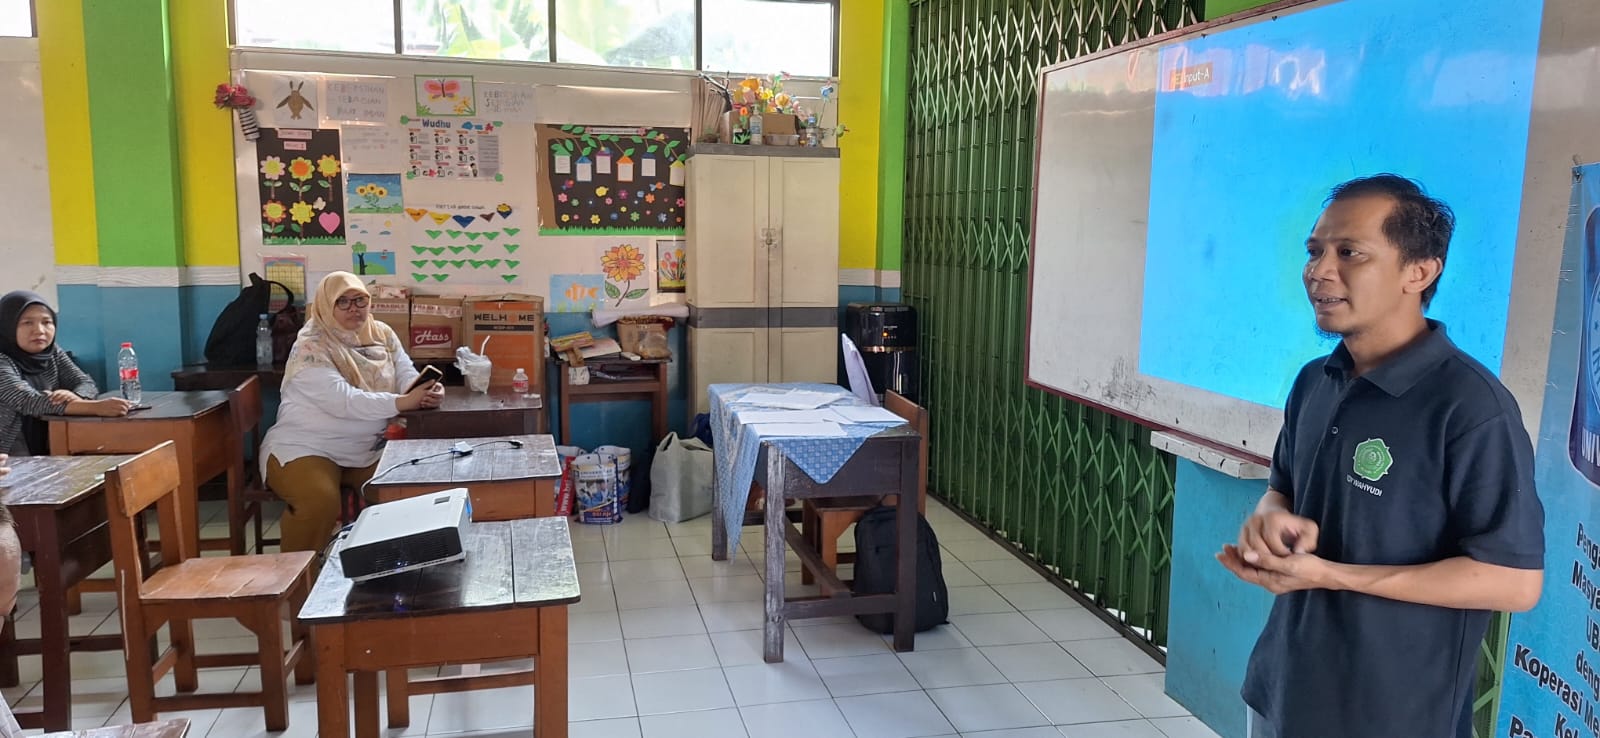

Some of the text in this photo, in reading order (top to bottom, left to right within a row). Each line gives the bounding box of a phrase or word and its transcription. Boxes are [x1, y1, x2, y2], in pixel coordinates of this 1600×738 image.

[422, 118, 451, 128] Wudhu
[415, 330, 449, 344] Hass
[1514, 644, 1584, 715] Koperasi
